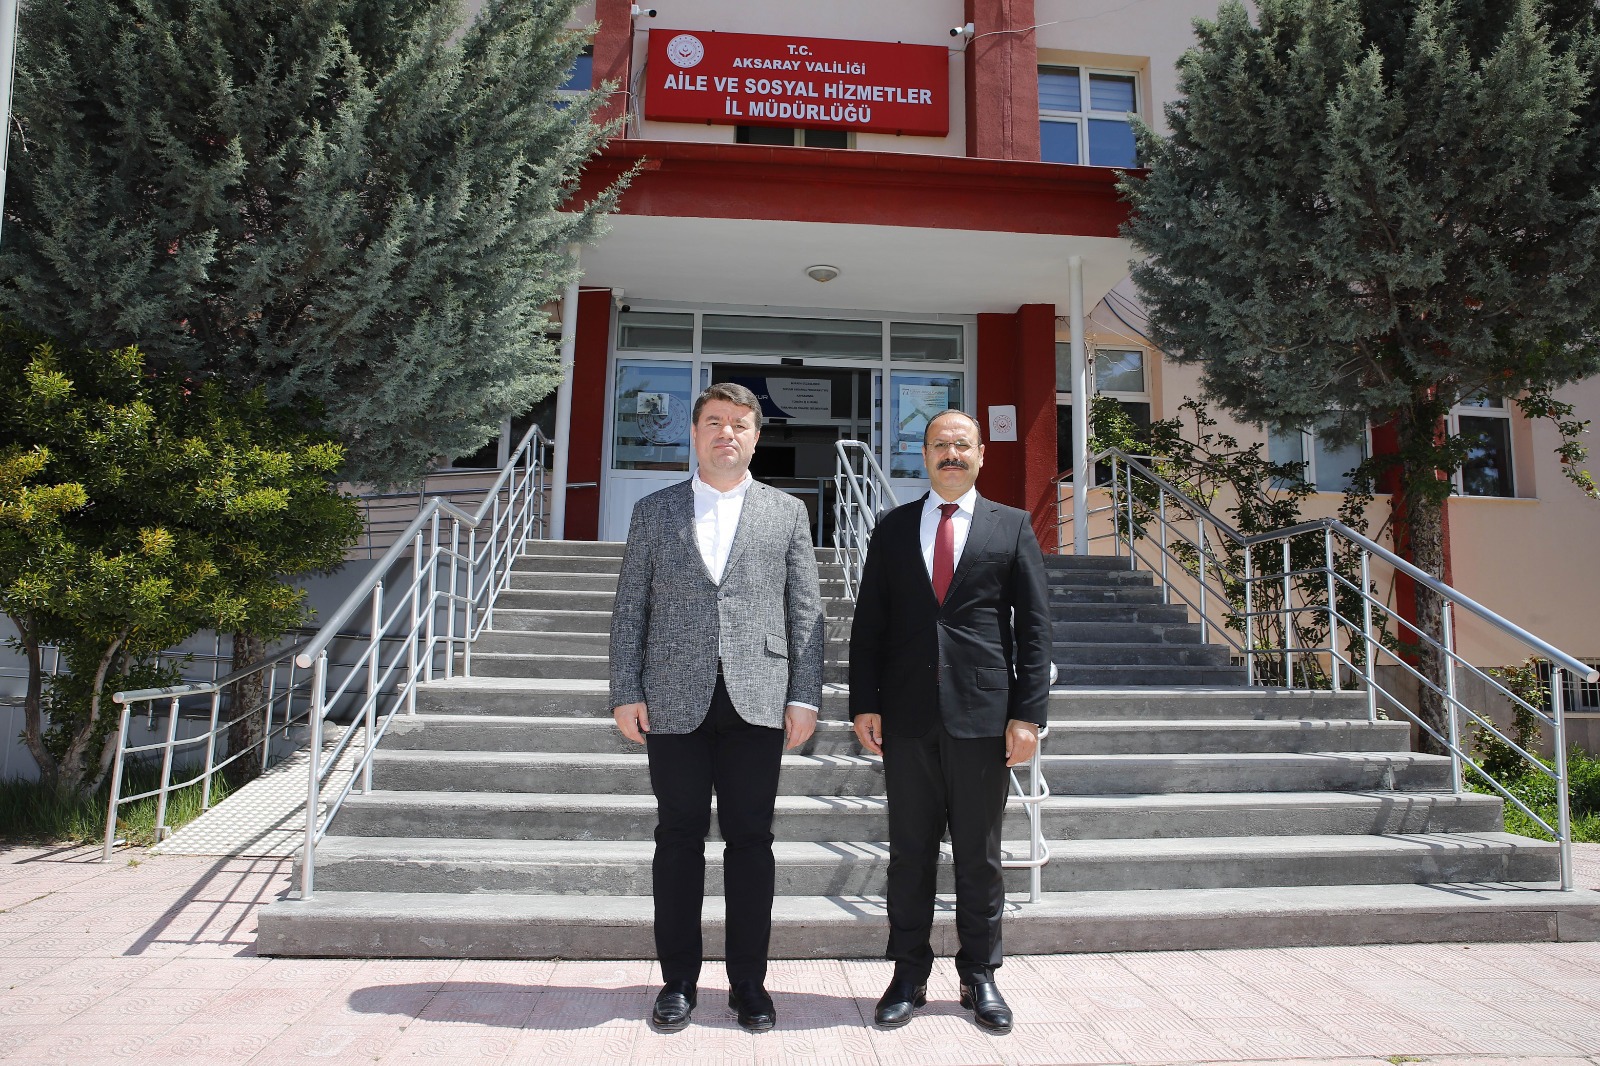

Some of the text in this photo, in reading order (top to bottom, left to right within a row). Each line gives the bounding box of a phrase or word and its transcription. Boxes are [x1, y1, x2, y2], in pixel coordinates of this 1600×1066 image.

[786, 44, 813, 56] T.C.
[732, 57, 866, 75] AKSARAY VALİLİĞİ
[663, 72, 932, 105] AİLE VE SOSYAL HİZMETLER
[725, 96, 872, 123] İL MÜDÜRLÜĞÜ
